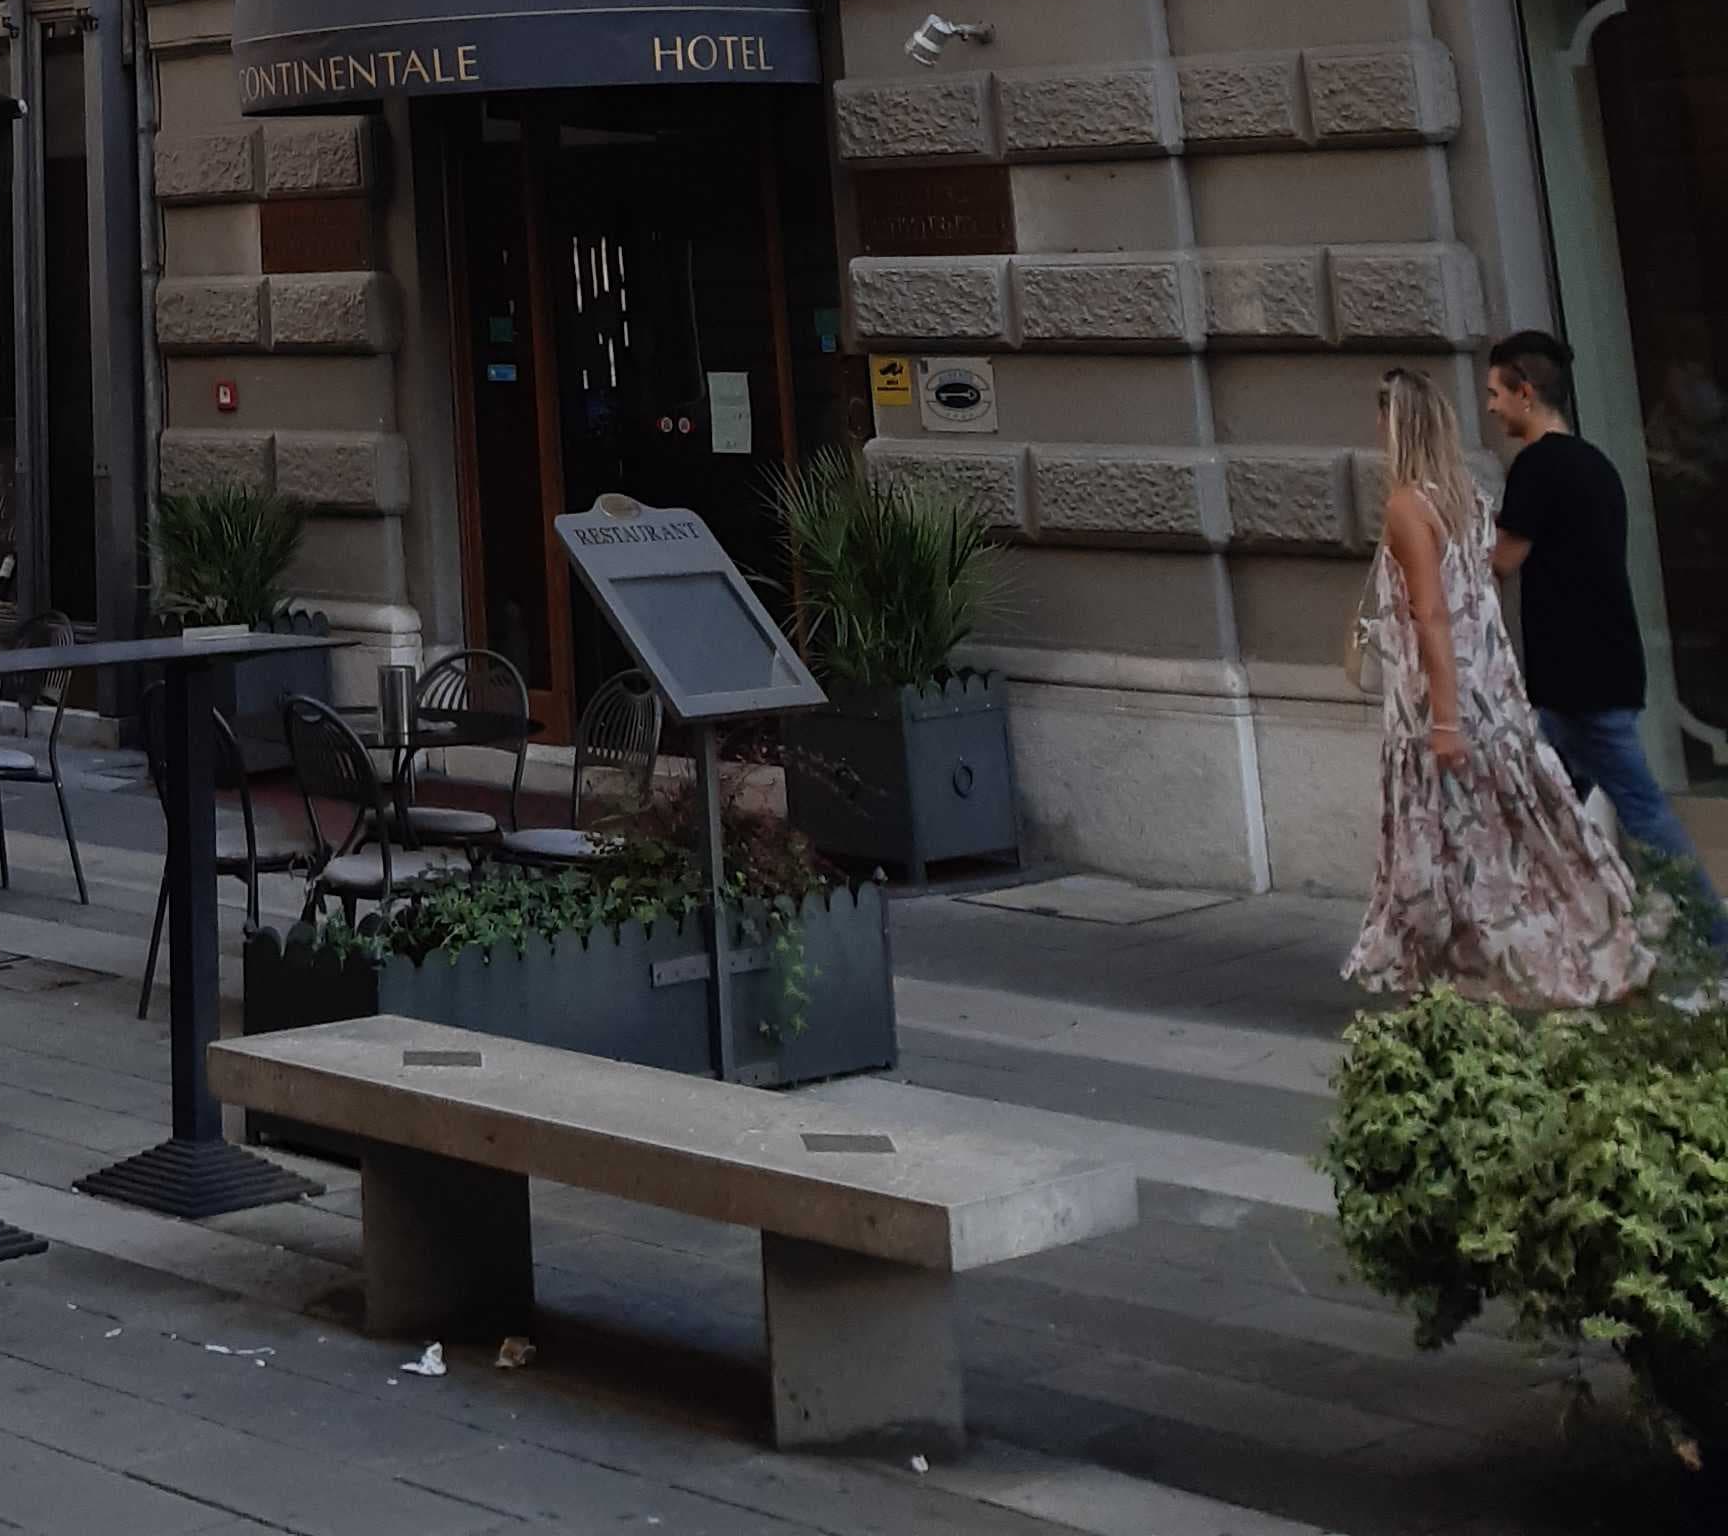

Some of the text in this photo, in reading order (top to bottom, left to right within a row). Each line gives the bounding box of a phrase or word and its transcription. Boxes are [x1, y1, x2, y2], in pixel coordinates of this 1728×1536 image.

[653, 34, 774, 72] HOTEL
[239, 45, 480, 103] CONTINENTALE
[574, 522, 700, 546] RESTAURANT
